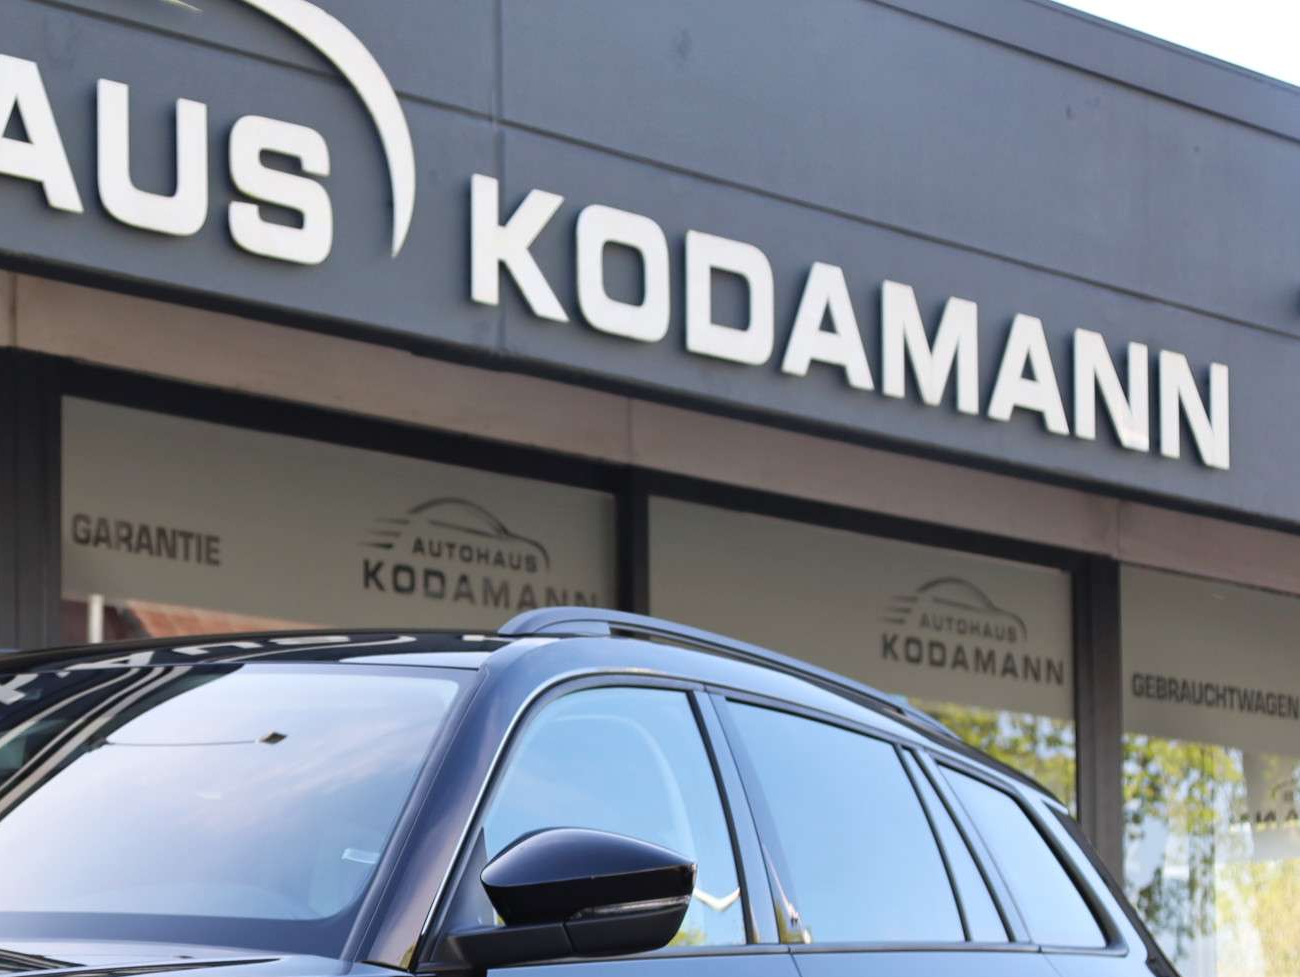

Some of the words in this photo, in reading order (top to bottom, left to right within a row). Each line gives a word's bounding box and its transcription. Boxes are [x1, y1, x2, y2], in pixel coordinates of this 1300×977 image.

[471, 173, 1231, 470] KODAMANN
[71, 512, 221, 567] GARANTIE
[411, 536, 538, 574] AUTOHAUS
[919, 612, 1018, 643] AUTOHAUS
[881, 633, 1064, 686] KODAMANN
[1131, 672, 1300, 720] GEBRAUCHTWAGEN
